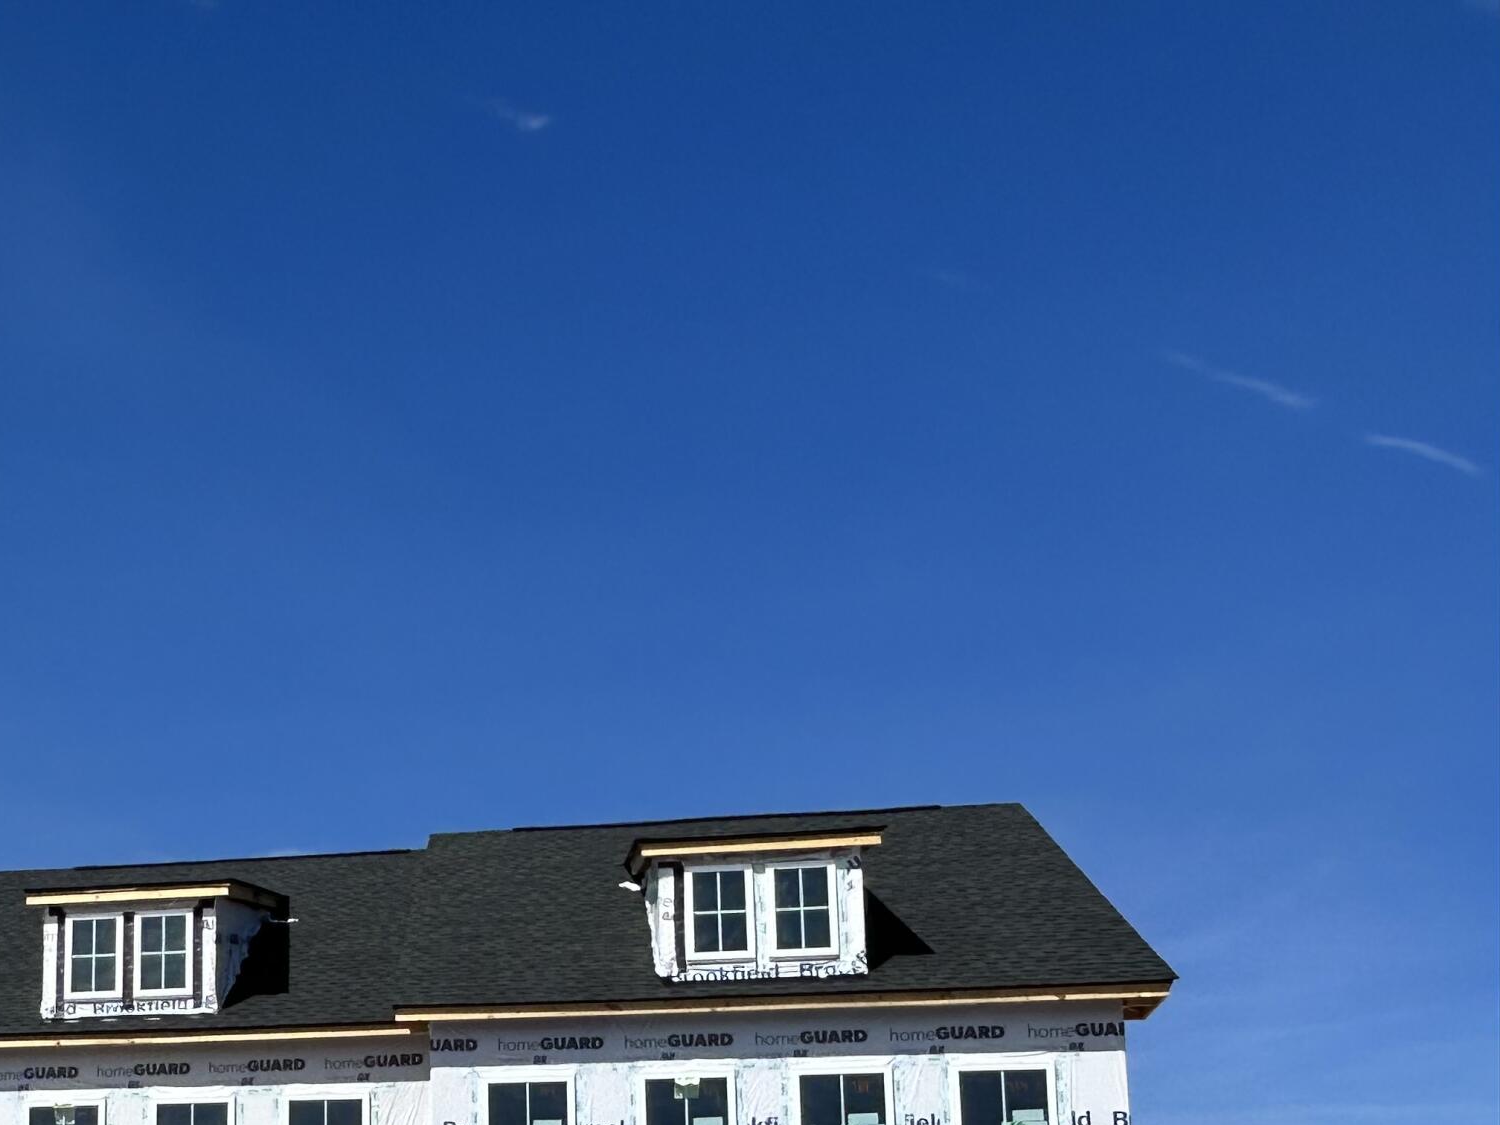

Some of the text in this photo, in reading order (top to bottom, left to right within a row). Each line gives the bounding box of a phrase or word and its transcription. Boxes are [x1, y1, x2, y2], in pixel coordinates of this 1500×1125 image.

[624, 1032, 734, 1049] homeGUARD
[755, 1028, 868, 1045] homeGUARD
[889, 1025, 1004, 1041] homeGUARD
[498, 1037, 604, 1051] homeGUARD
[209, 1058, 305, 1074] homeGUARD
[324, 1053, 423, 1069] homeGUARD
[97, 1063, 190, 1078] homeGUARD
